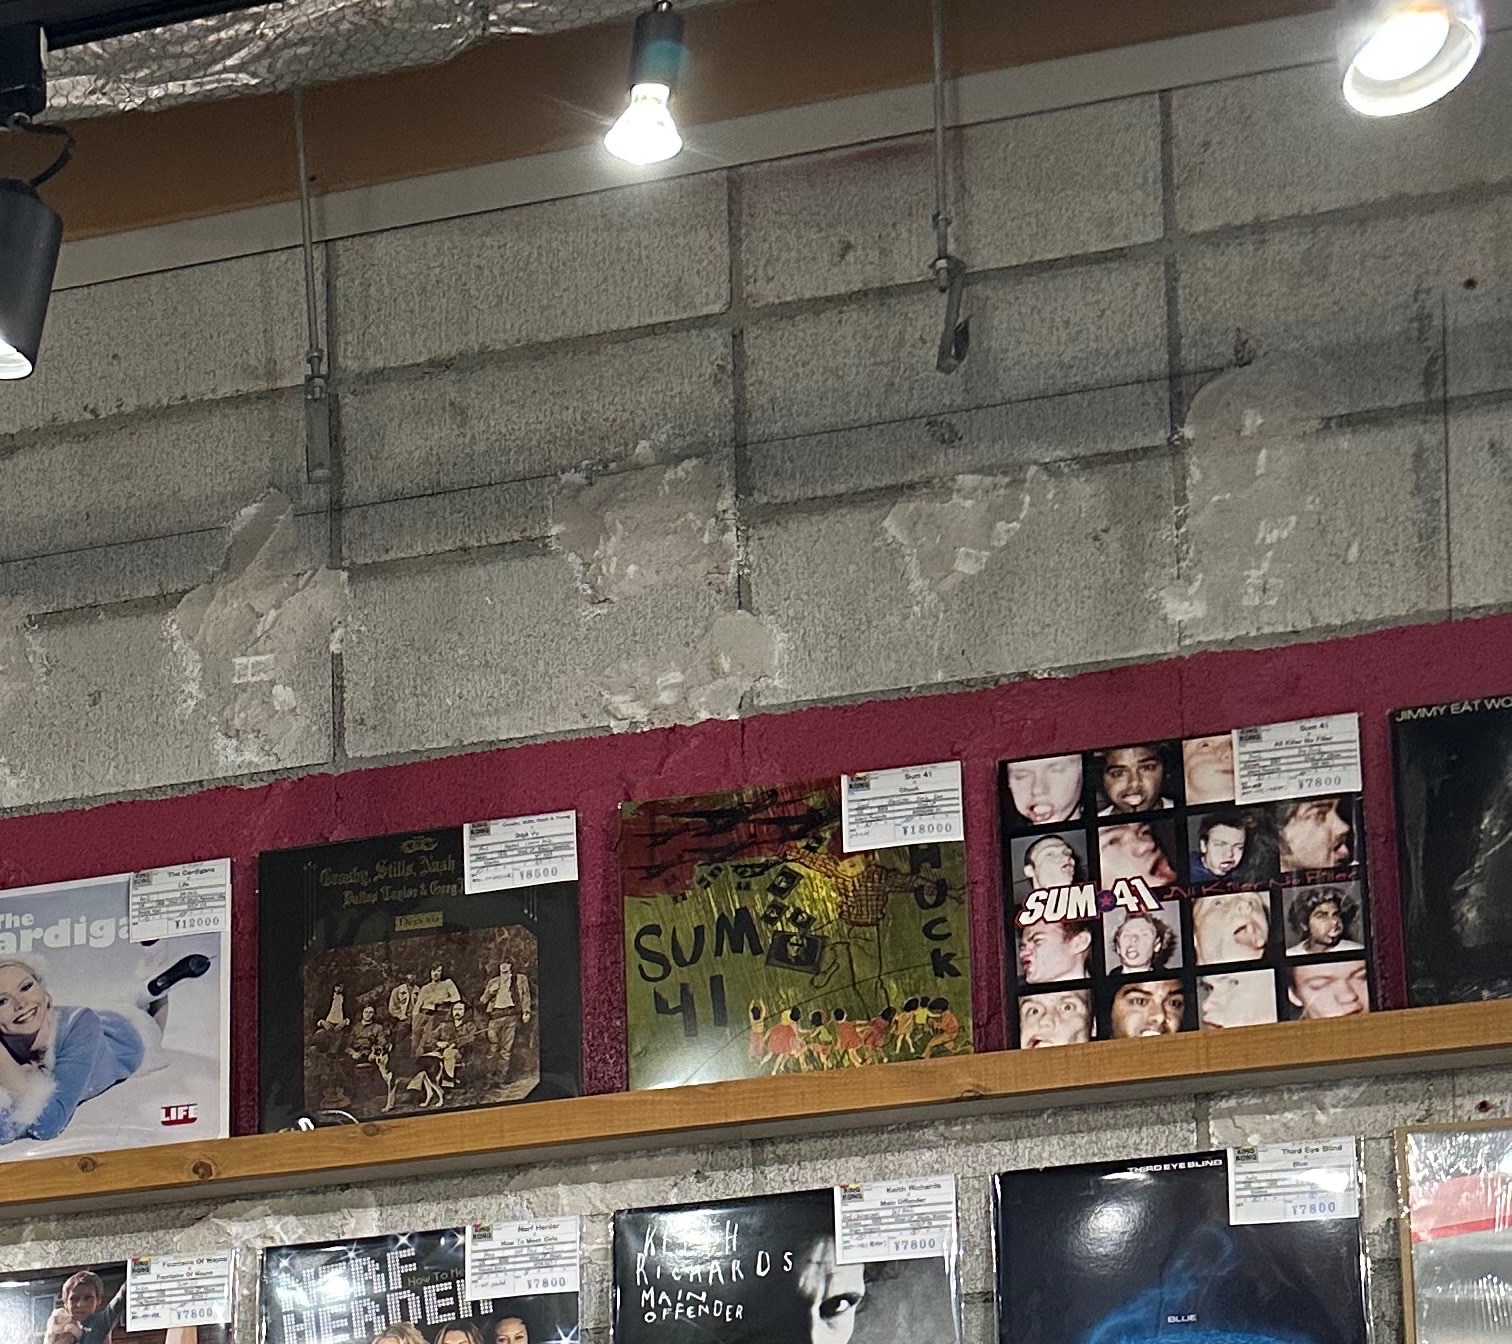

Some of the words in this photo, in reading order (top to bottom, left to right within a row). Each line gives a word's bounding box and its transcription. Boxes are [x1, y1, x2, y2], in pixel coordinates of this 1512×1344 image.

[1395, 704, 1447, 722] JIMMY
[1451, 700, 1481, 714] EAT
[902, 823, 952, 836] ¥18000
[1019, 885, 1096, 924] SUM
[1112, 877, 1159, 911] 41
[634, 906, 763, 982] SUM
[654, 974, 729, 1037] 41
[160, 1103, 199, 1124] LIFE
[1297, 1202, 1341, 1215] ¥7800
[894, 1238, 936, 1251] ¥7800
[641, 1286, 707, 1308] MAIN
[177, 1308, 213, 1320] ¥7800
[644, 1300, 744, 1323] OFFENDER
